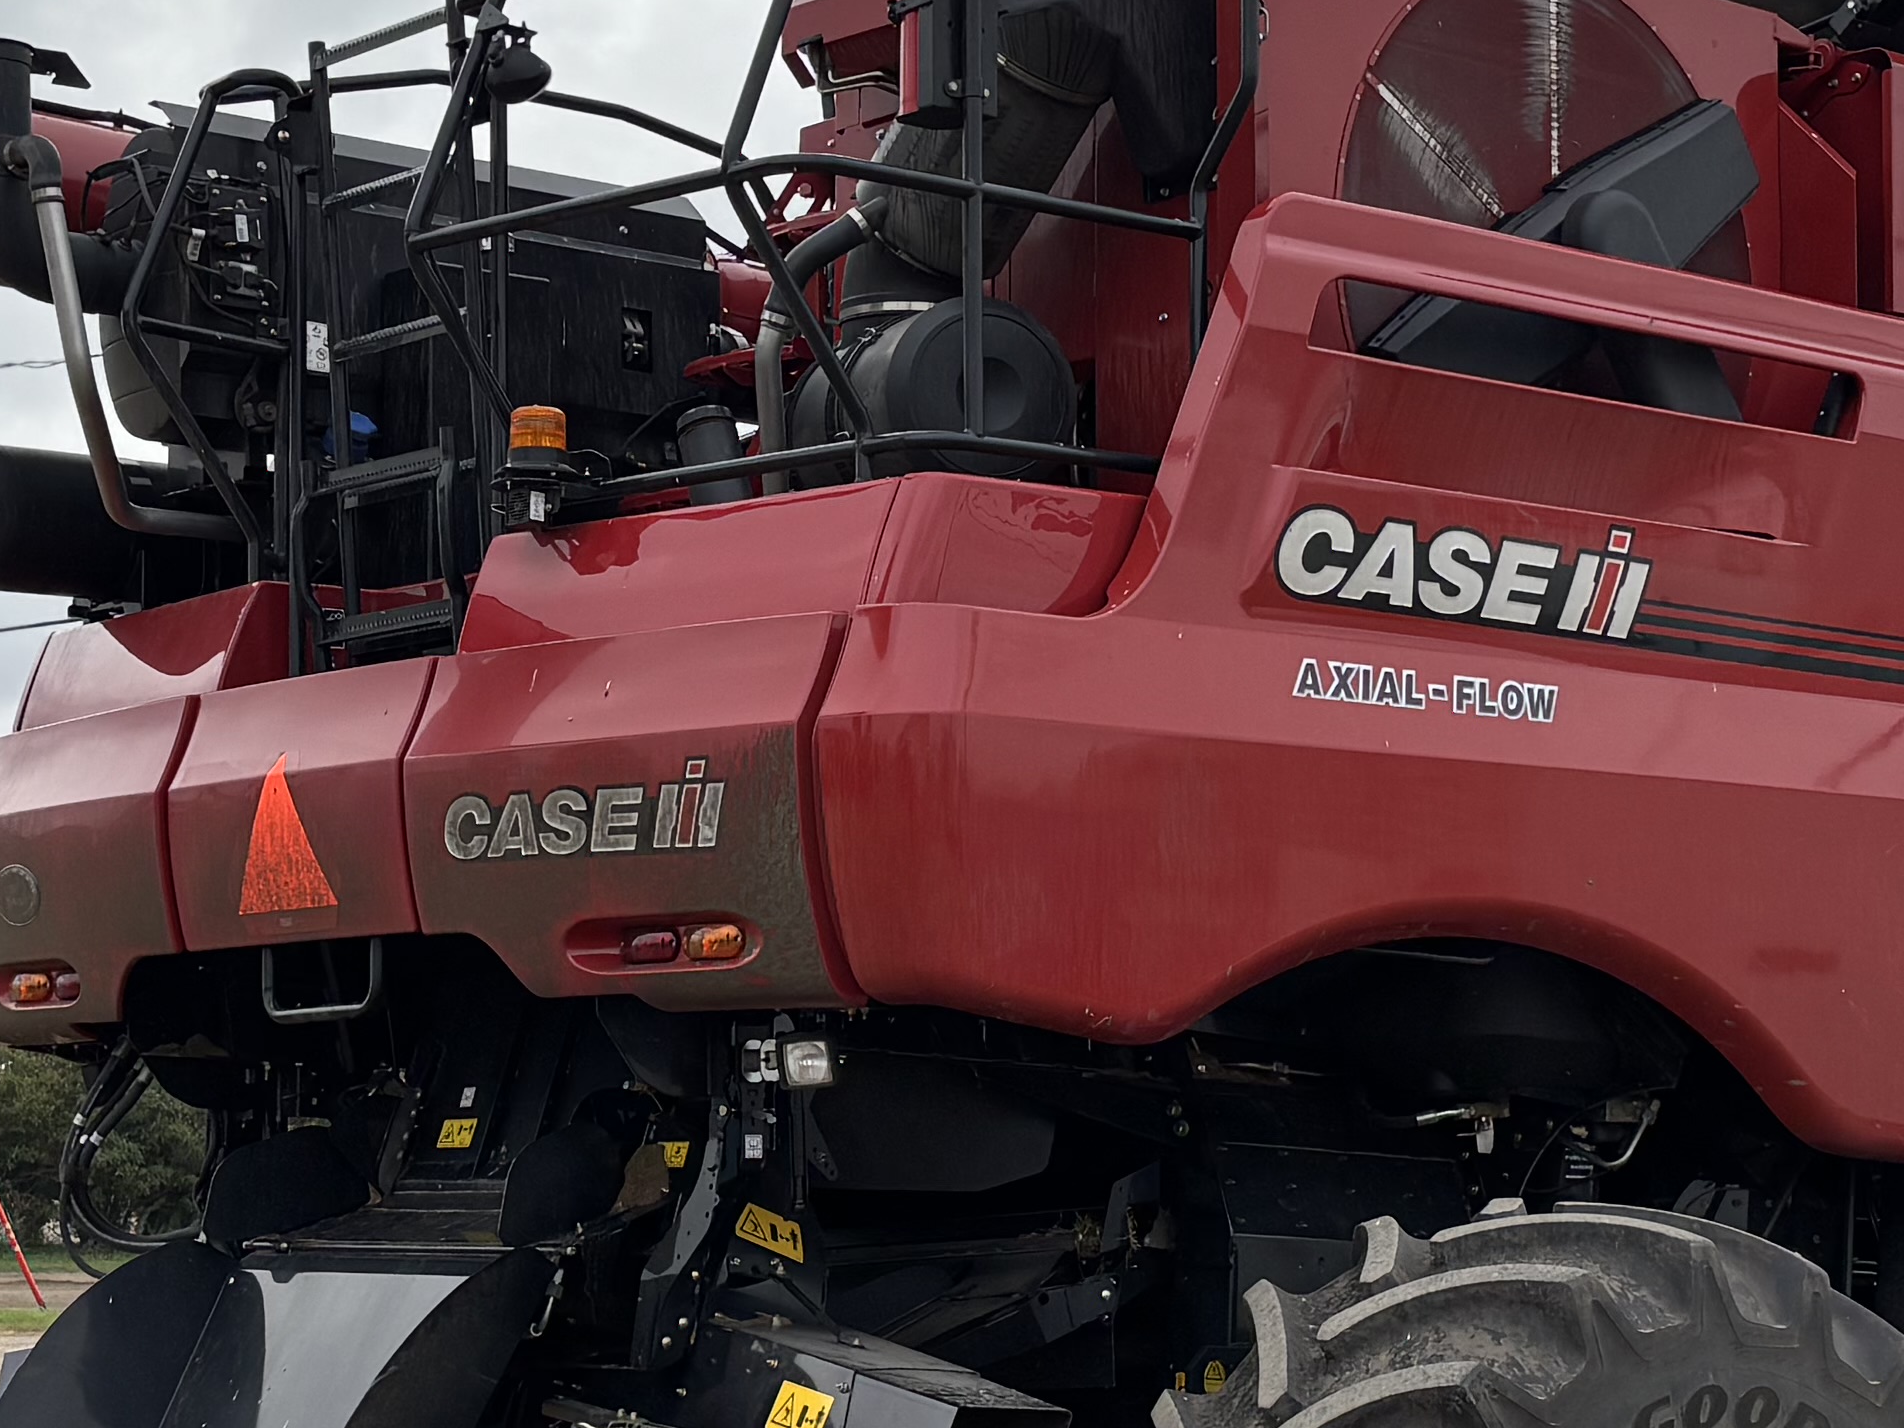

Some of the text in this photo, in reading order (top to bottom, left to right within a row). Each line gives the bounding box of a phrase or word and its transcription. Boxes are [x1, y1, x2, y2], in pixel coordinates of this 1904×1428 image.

[1276, 508, 1560, 625] CASE
[1292, 658, 1558, 722] AXIAL-FLOW
[444, 786, 643, 860] CASE
